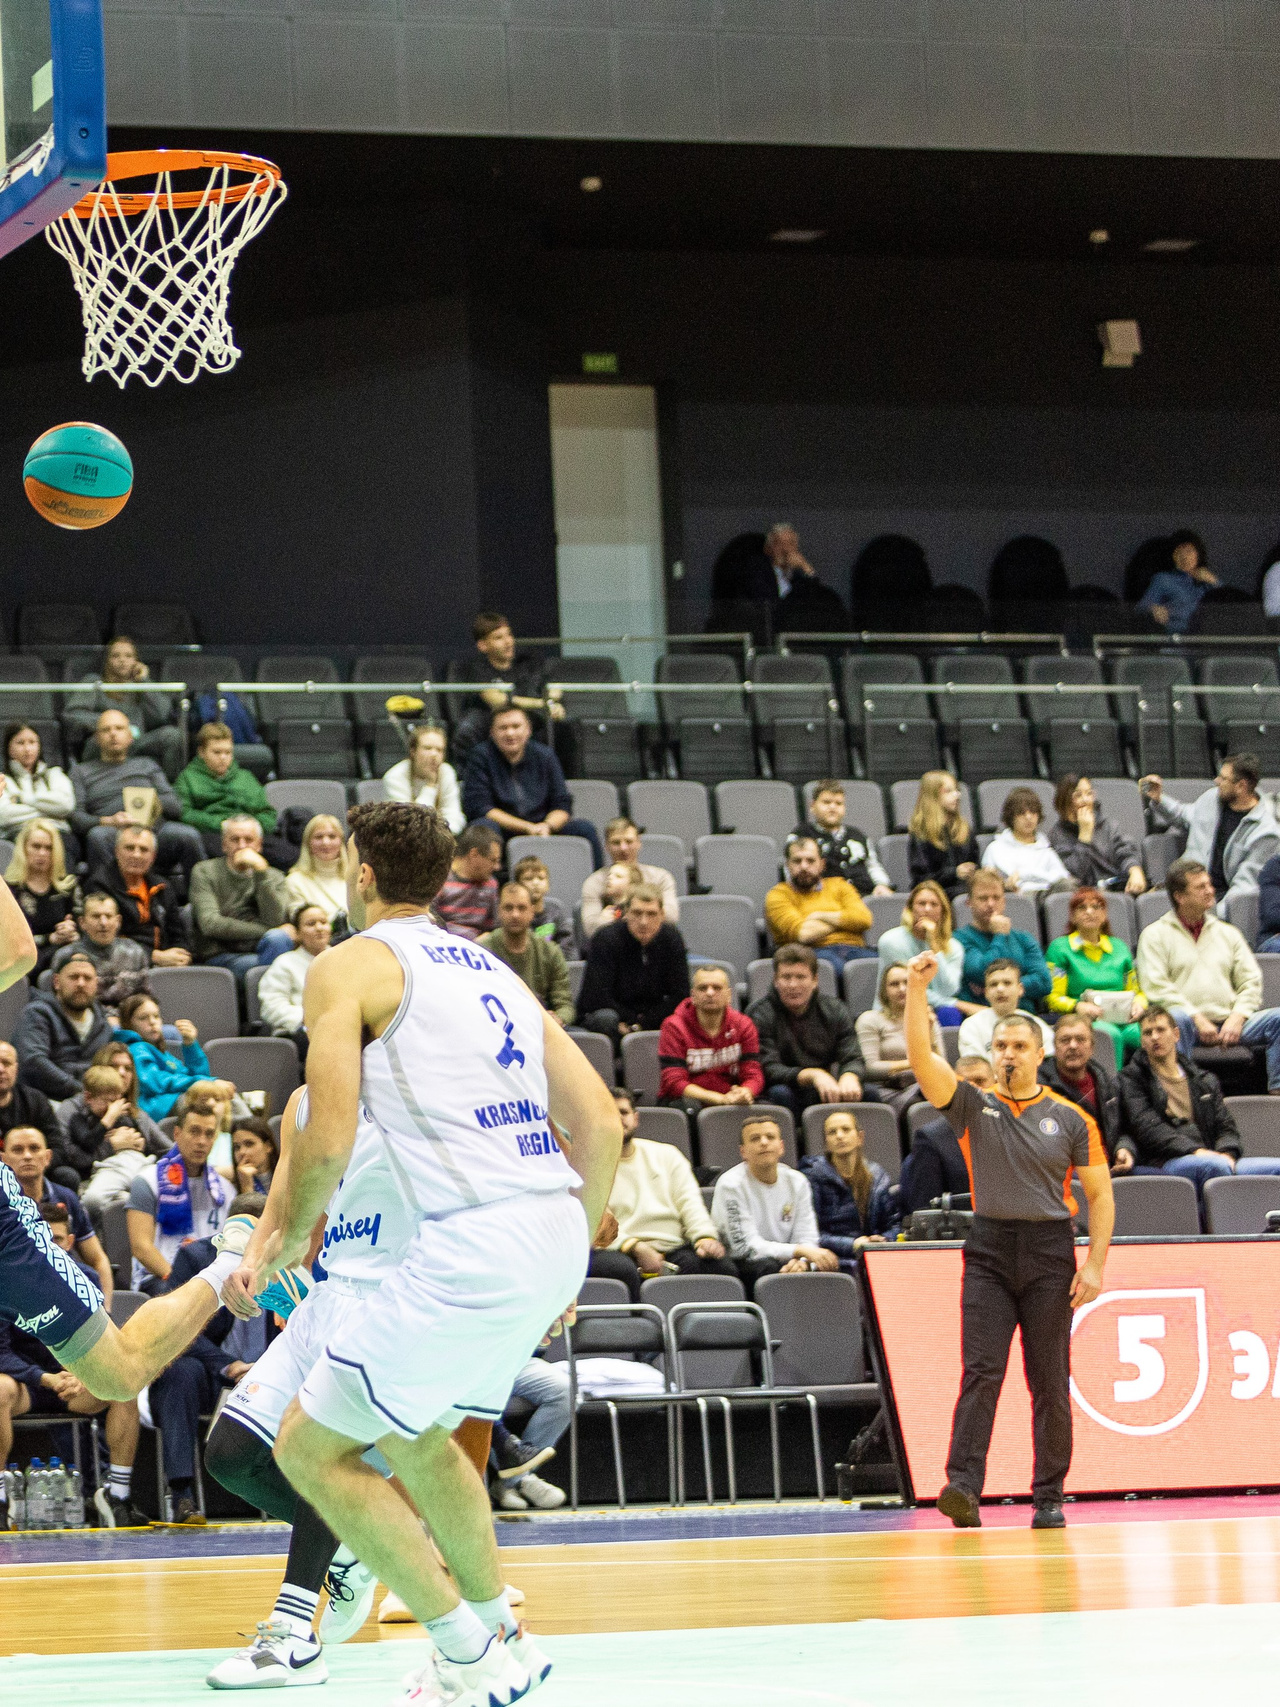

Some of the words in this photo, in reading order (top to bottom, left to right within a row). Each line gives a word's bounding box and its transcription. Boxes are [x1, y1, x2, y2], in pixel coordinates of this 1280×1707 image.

[74, 463, 99, 478] FIBA
[480, 993, 525, 1069] 2
[516, 1131, 561, 1157] REGIO
[207, 1207, 220, 1230] 4
[323, 1213, 382, 1256] nisey
[1113, 1314, 1166, 1403] 5
[1228, 1330, 1280, 1399] э
